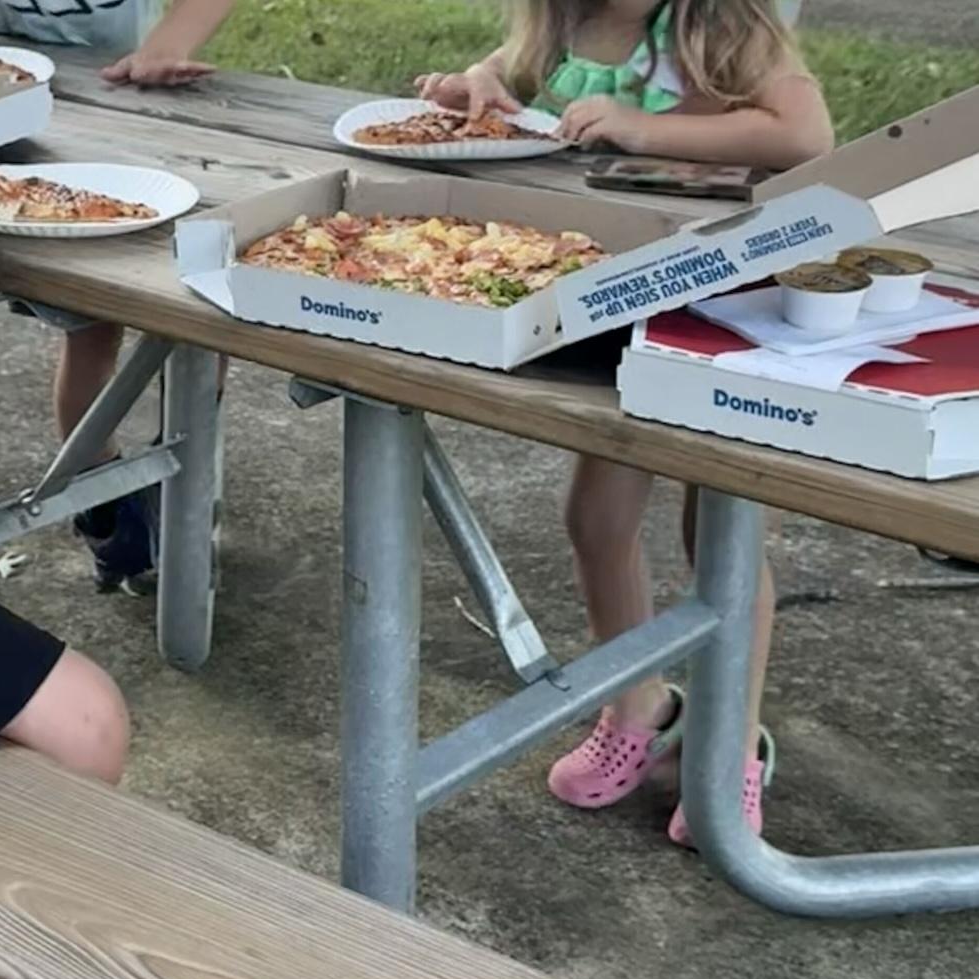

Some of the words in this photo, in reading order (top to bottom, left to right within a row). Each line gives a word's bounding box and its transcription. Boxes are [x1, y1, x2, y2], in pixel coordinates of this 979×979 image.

[693, 261, 739, 288] WHEN
[626, 287, 661, 309] SIGN
[661, 277, 692, 298] YOU
[301, 295, 381, 324] Domino's
[605, 301, 625, 317] UP
[714, 388, 816, 426] Domino's
